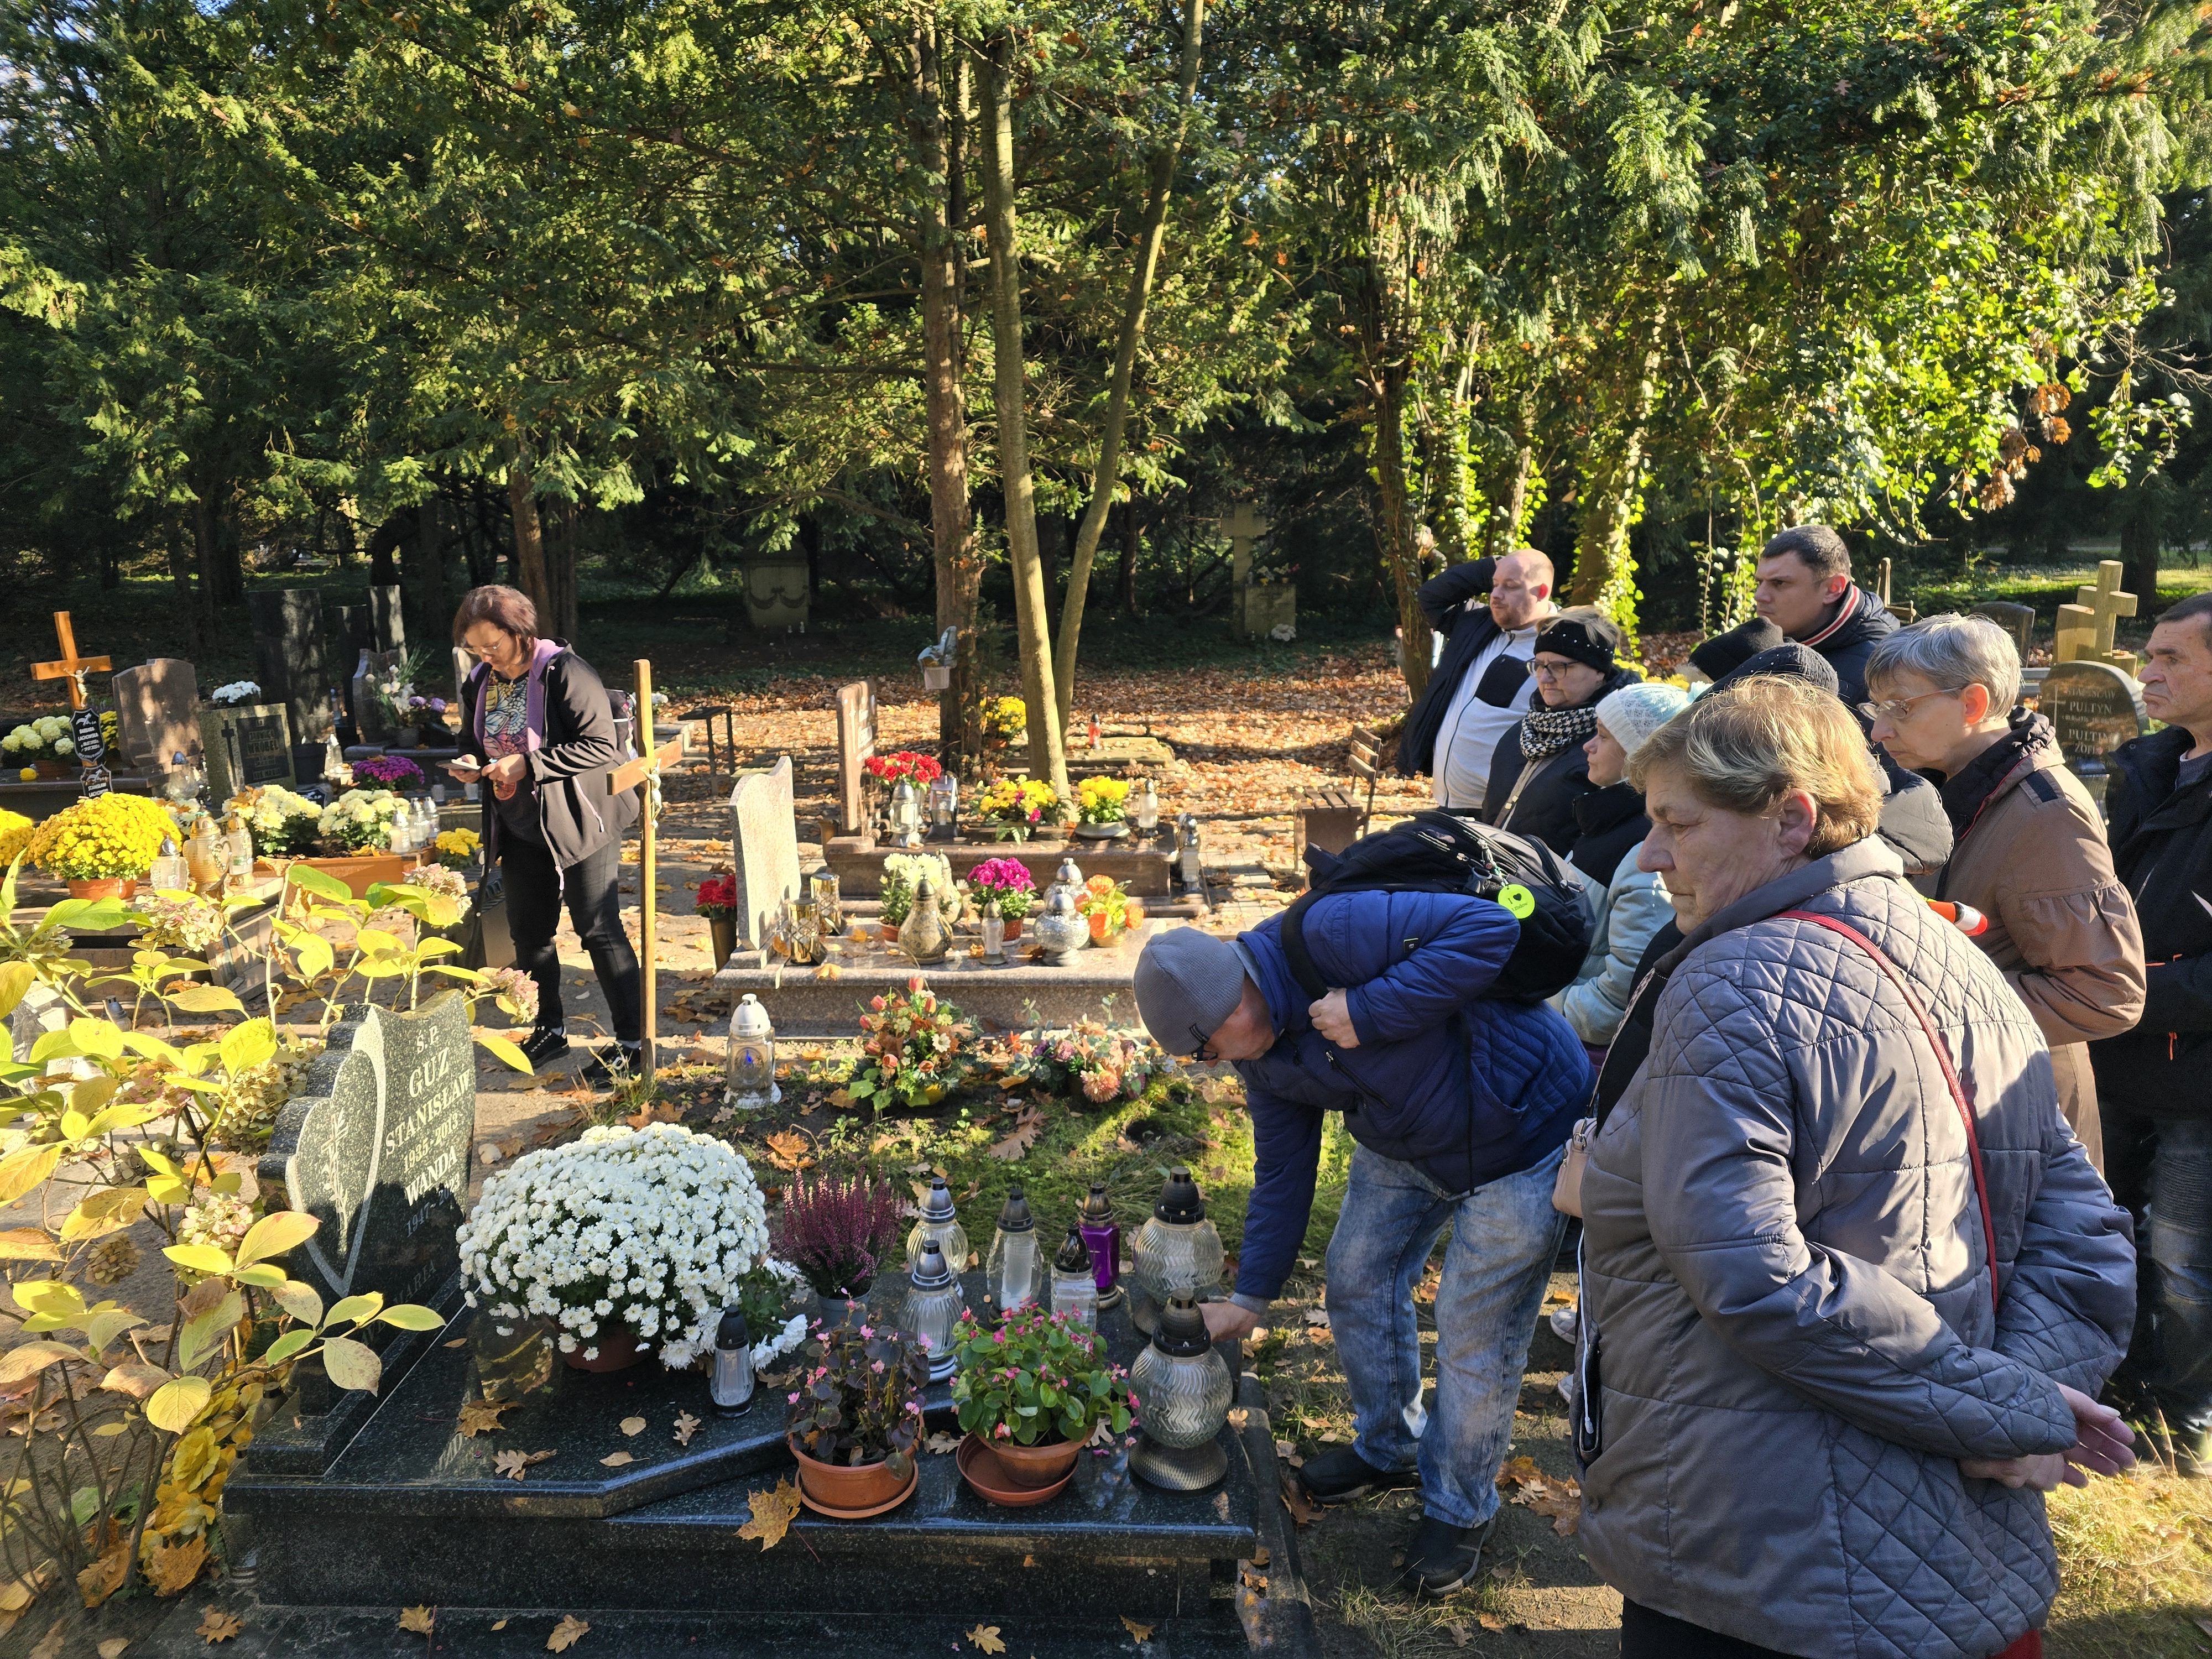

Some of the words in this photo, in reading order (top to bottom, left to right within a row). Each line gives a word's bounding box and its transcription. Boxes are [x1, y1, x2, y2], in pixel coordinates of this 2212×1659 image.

[409, 1047, 449, 1098] GUZ
[385, 1068, 470, 1158] STANISŁAW
[404, 1112, 458, 1173] 1935-2013
[405, 1145, 458, 1207] WANDA
